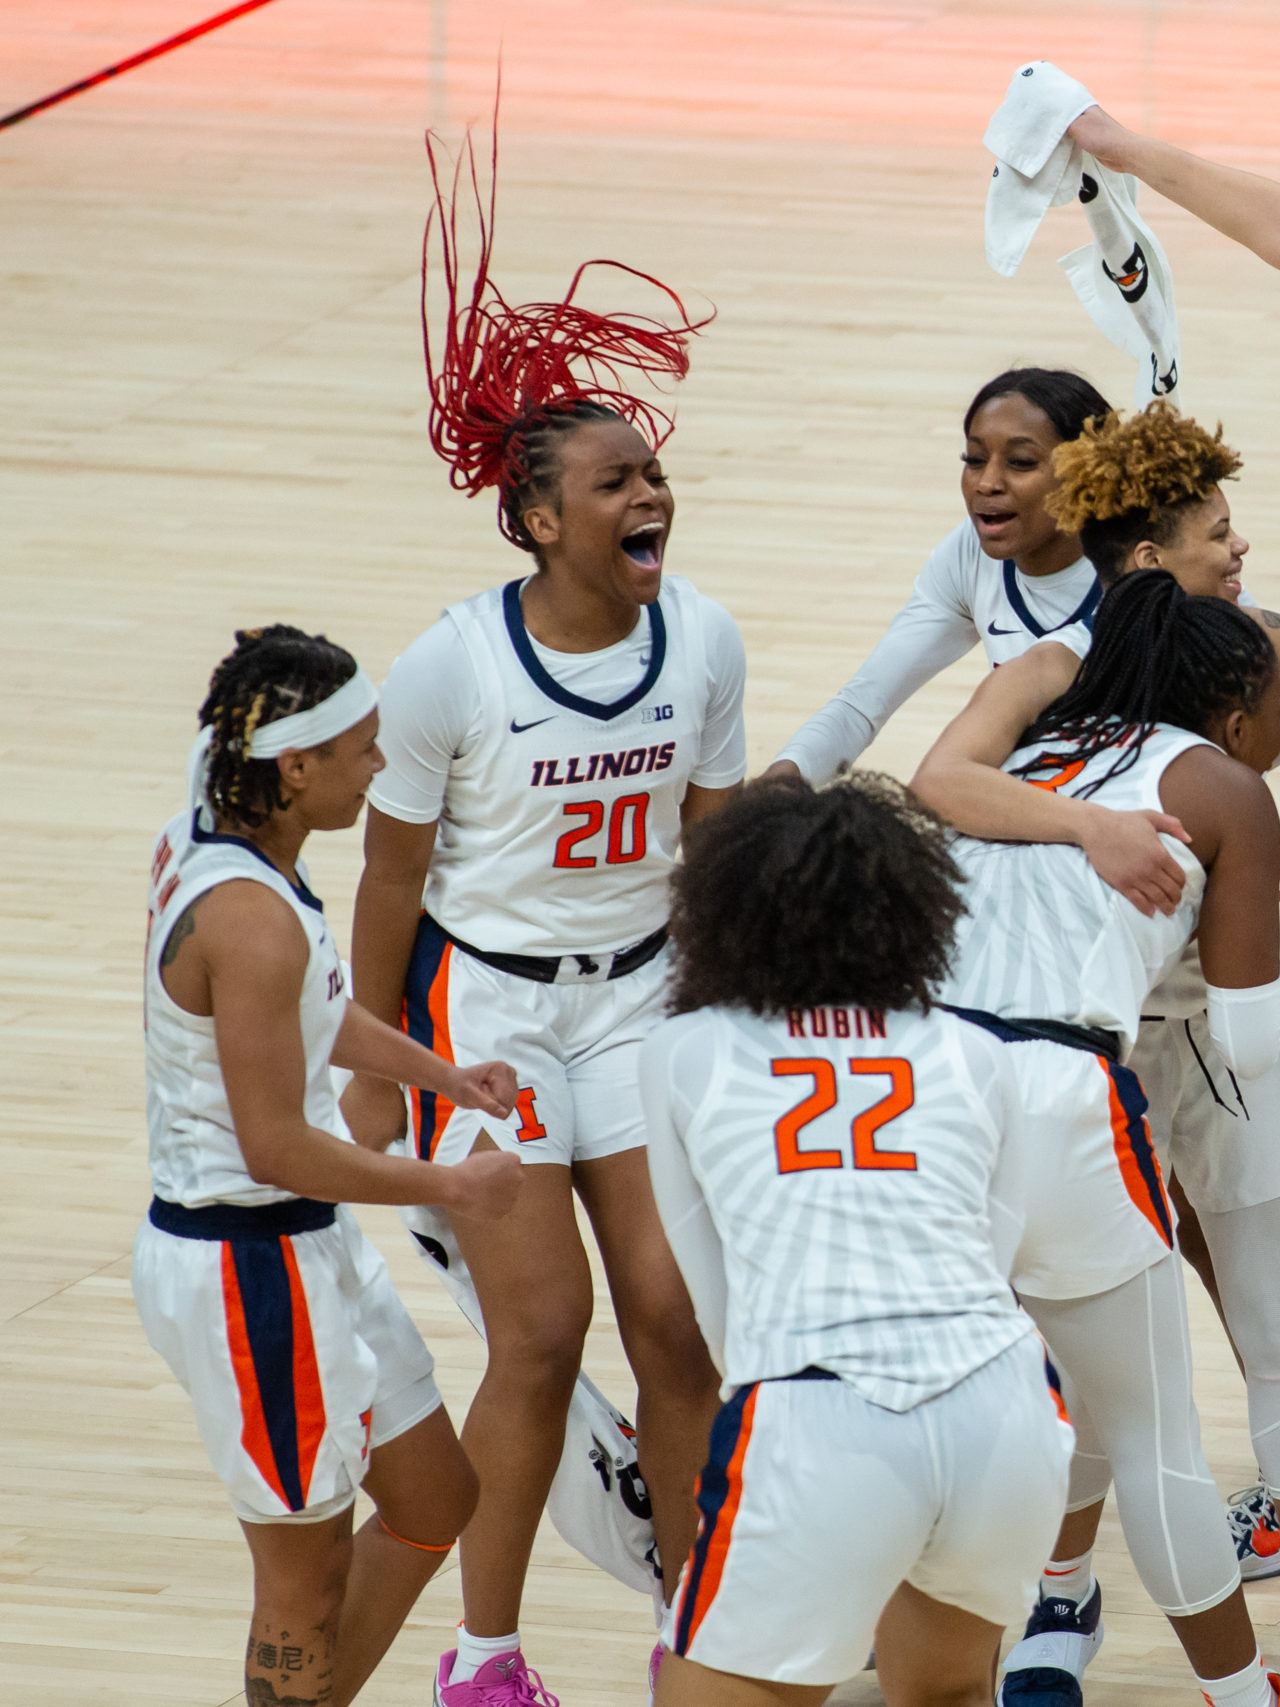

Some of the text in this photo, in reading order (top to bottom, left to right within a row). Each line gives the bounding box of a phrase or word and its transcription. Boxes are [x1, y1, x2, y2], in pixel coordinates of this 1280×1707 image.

[530, 741, 676, 786] ILLINOIS
[552, 792, 650, 868] 20
[786, 1007, 887, 1039] RUBIN
[770, 1057, 917, 1175] 22
